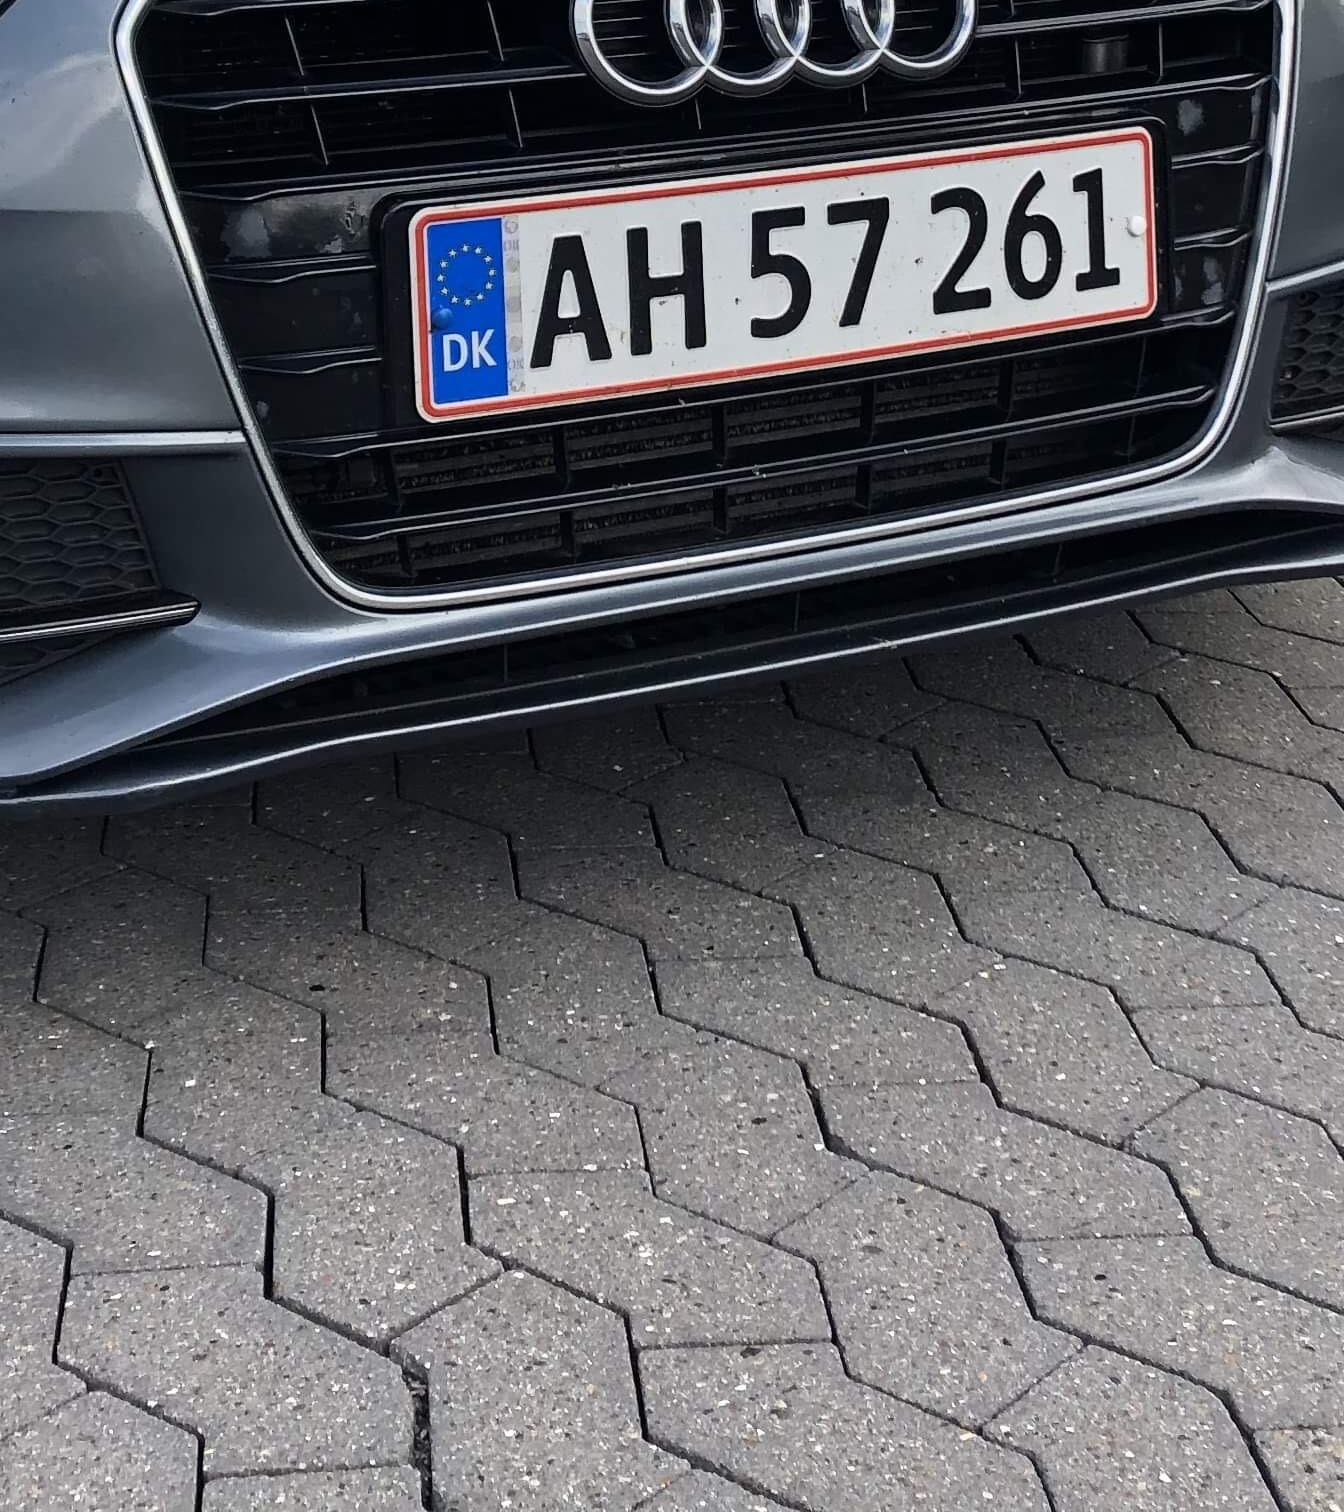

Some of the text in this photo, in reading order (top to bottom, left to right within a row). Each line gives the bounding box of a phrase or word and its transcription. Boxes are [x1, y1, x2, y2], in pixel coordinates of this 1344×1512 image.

[529, 167, 1121, 369] AH 57 261
[442, 329, 497, 372] DK
